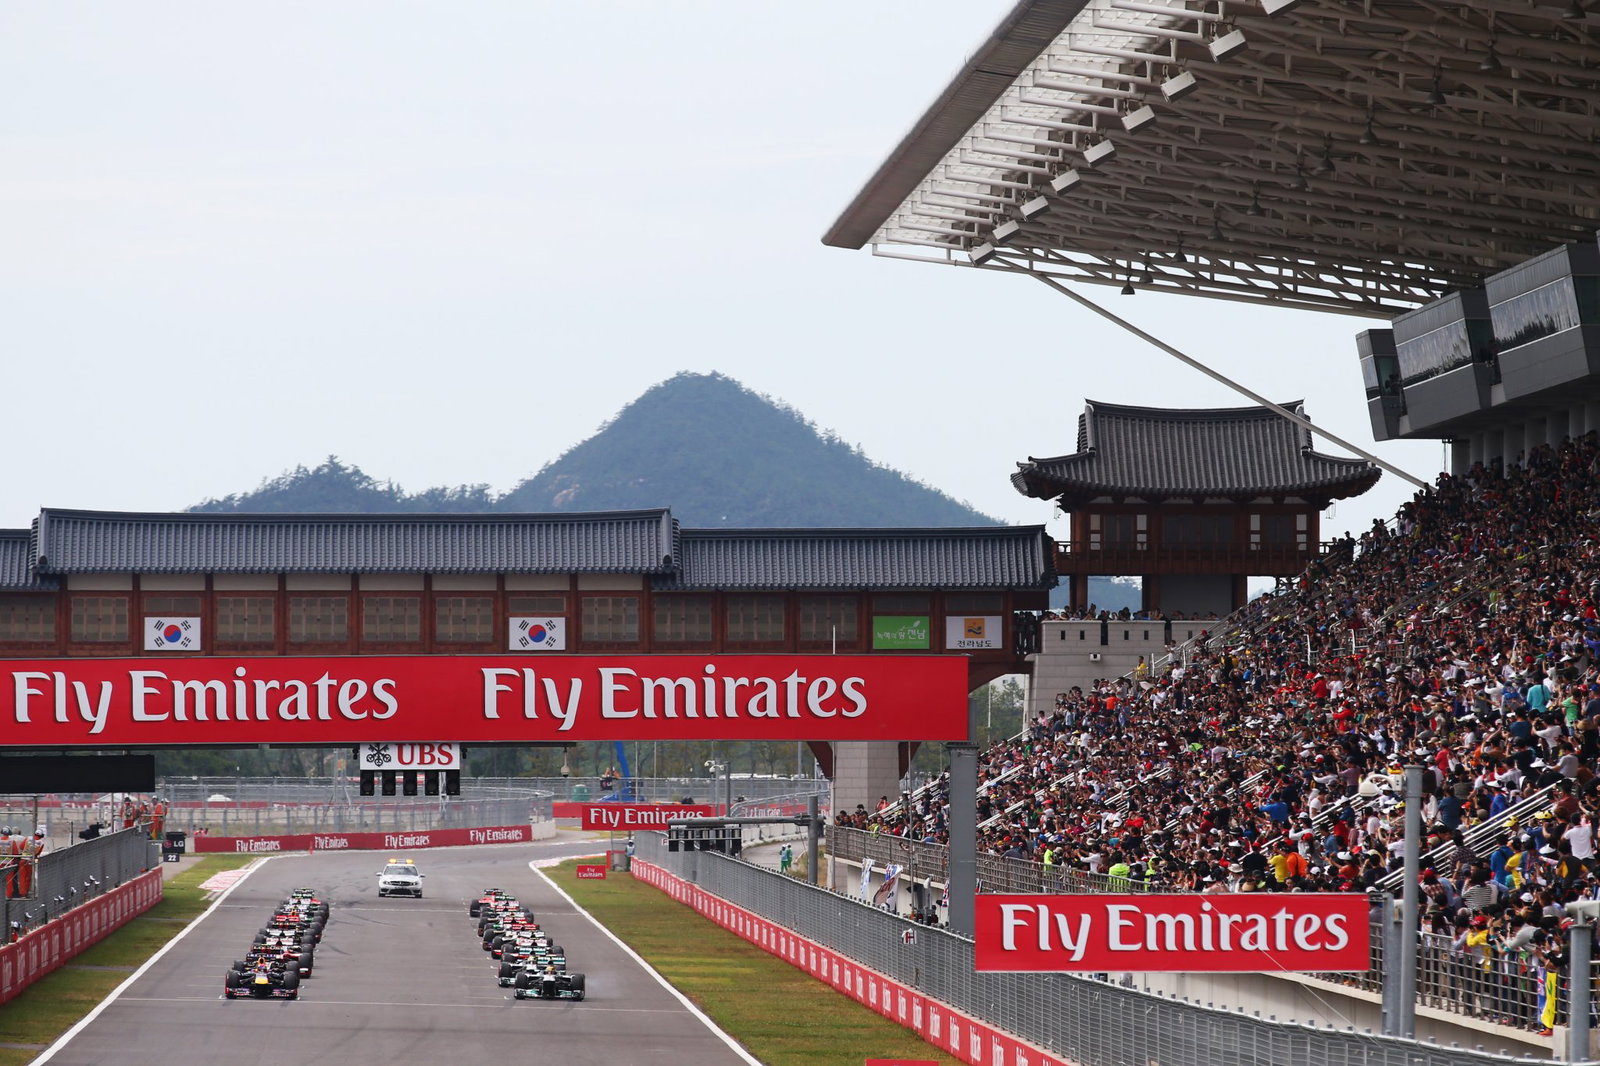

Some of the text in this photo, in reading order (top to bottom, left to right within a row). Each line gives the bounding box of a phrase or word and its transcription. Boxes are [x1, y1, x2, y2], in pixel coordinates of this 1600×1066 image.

[957, 639, 992, 648] 전라남도
[12, 667, 397, 733] Fly Emirates
[482, 664, 866, 730] Fly Emirates
[396, 743, 453, 765] UBS
[590, 807, 703, 828] Fly Emirates
[315, 836, 349, 849] Fly Emirates
[384, 833, 430, 848] Fly Emirates
[469, 828, 523, 844] Fly Emirates
[236, 838, 281, 852] Fly Emirates
[168, 854, 177, 862] 22
[1000, 901, 1348, 961] Fly Emirates
